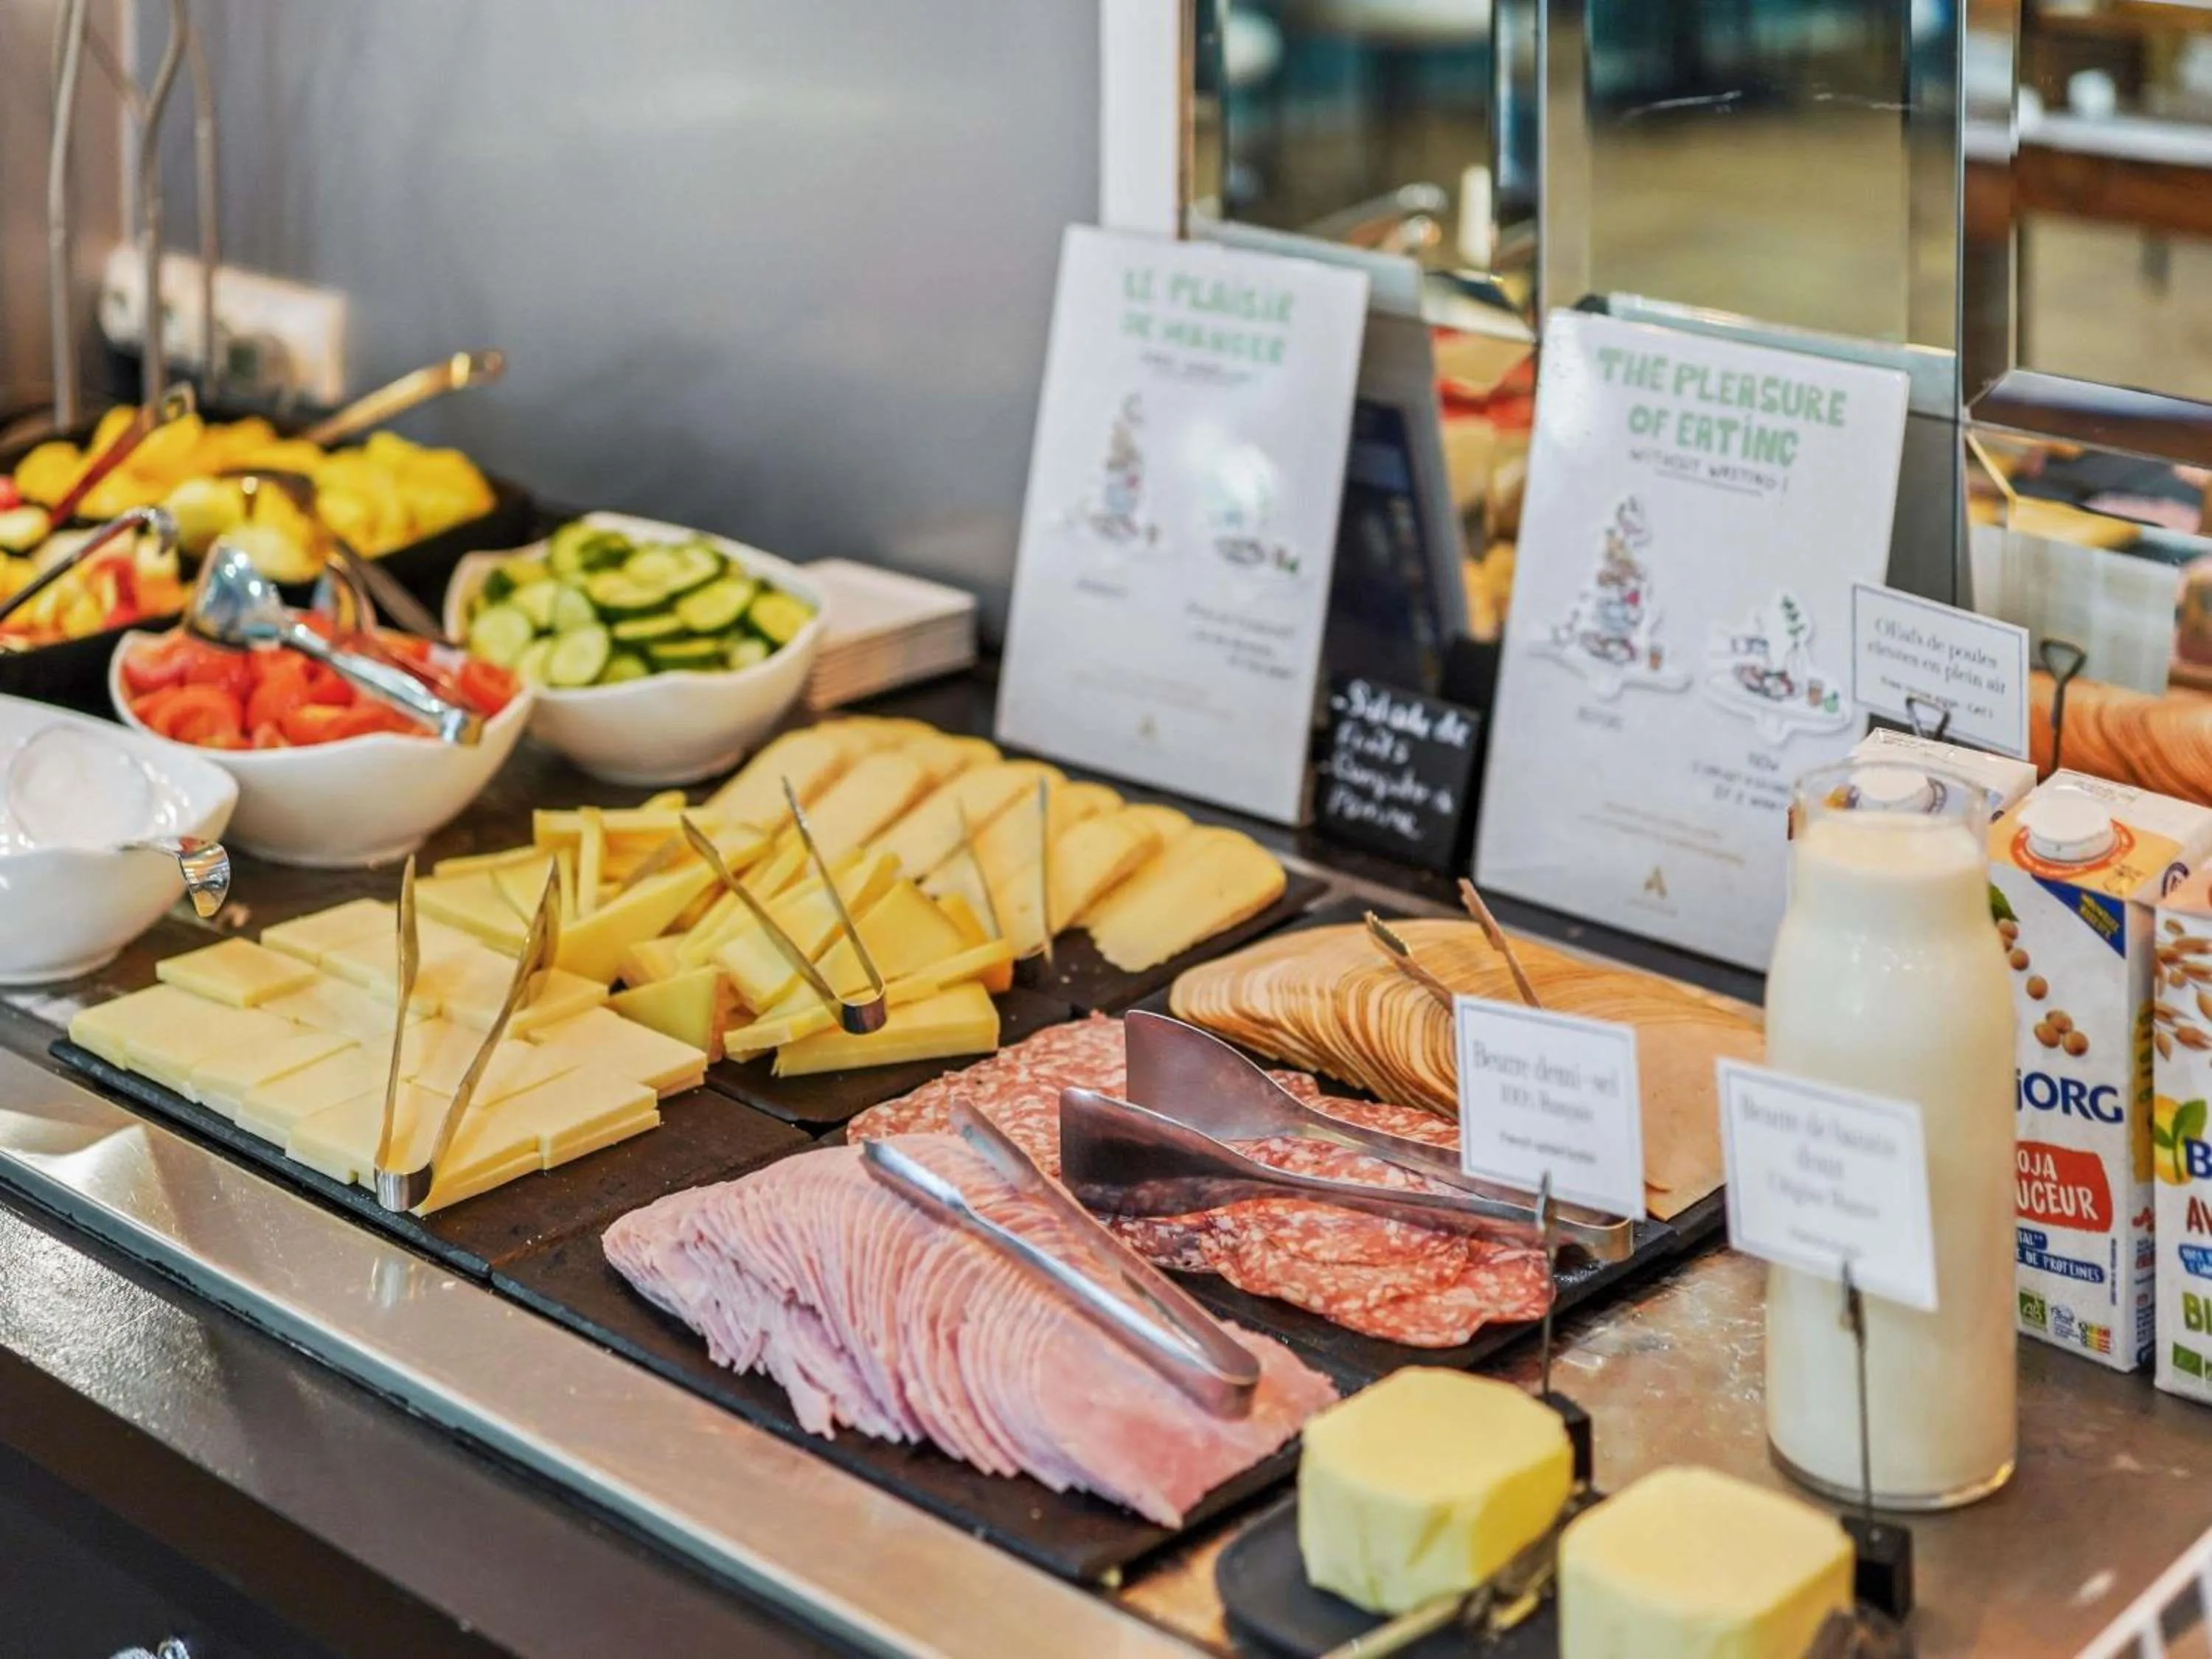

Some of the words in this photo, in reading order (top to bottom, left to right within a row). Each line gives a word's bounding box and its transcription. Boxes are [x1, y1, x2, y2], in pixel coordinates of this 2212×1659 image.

[1597, 347, 1669, 392] THE
[1673, 361, 1848, 428] PLEASURE
[1627, 403, 1669, 439] OF
[2017, 1150, 2058, 1180] OJA
[2017, 1180, 2099, 1221] UCEUR
